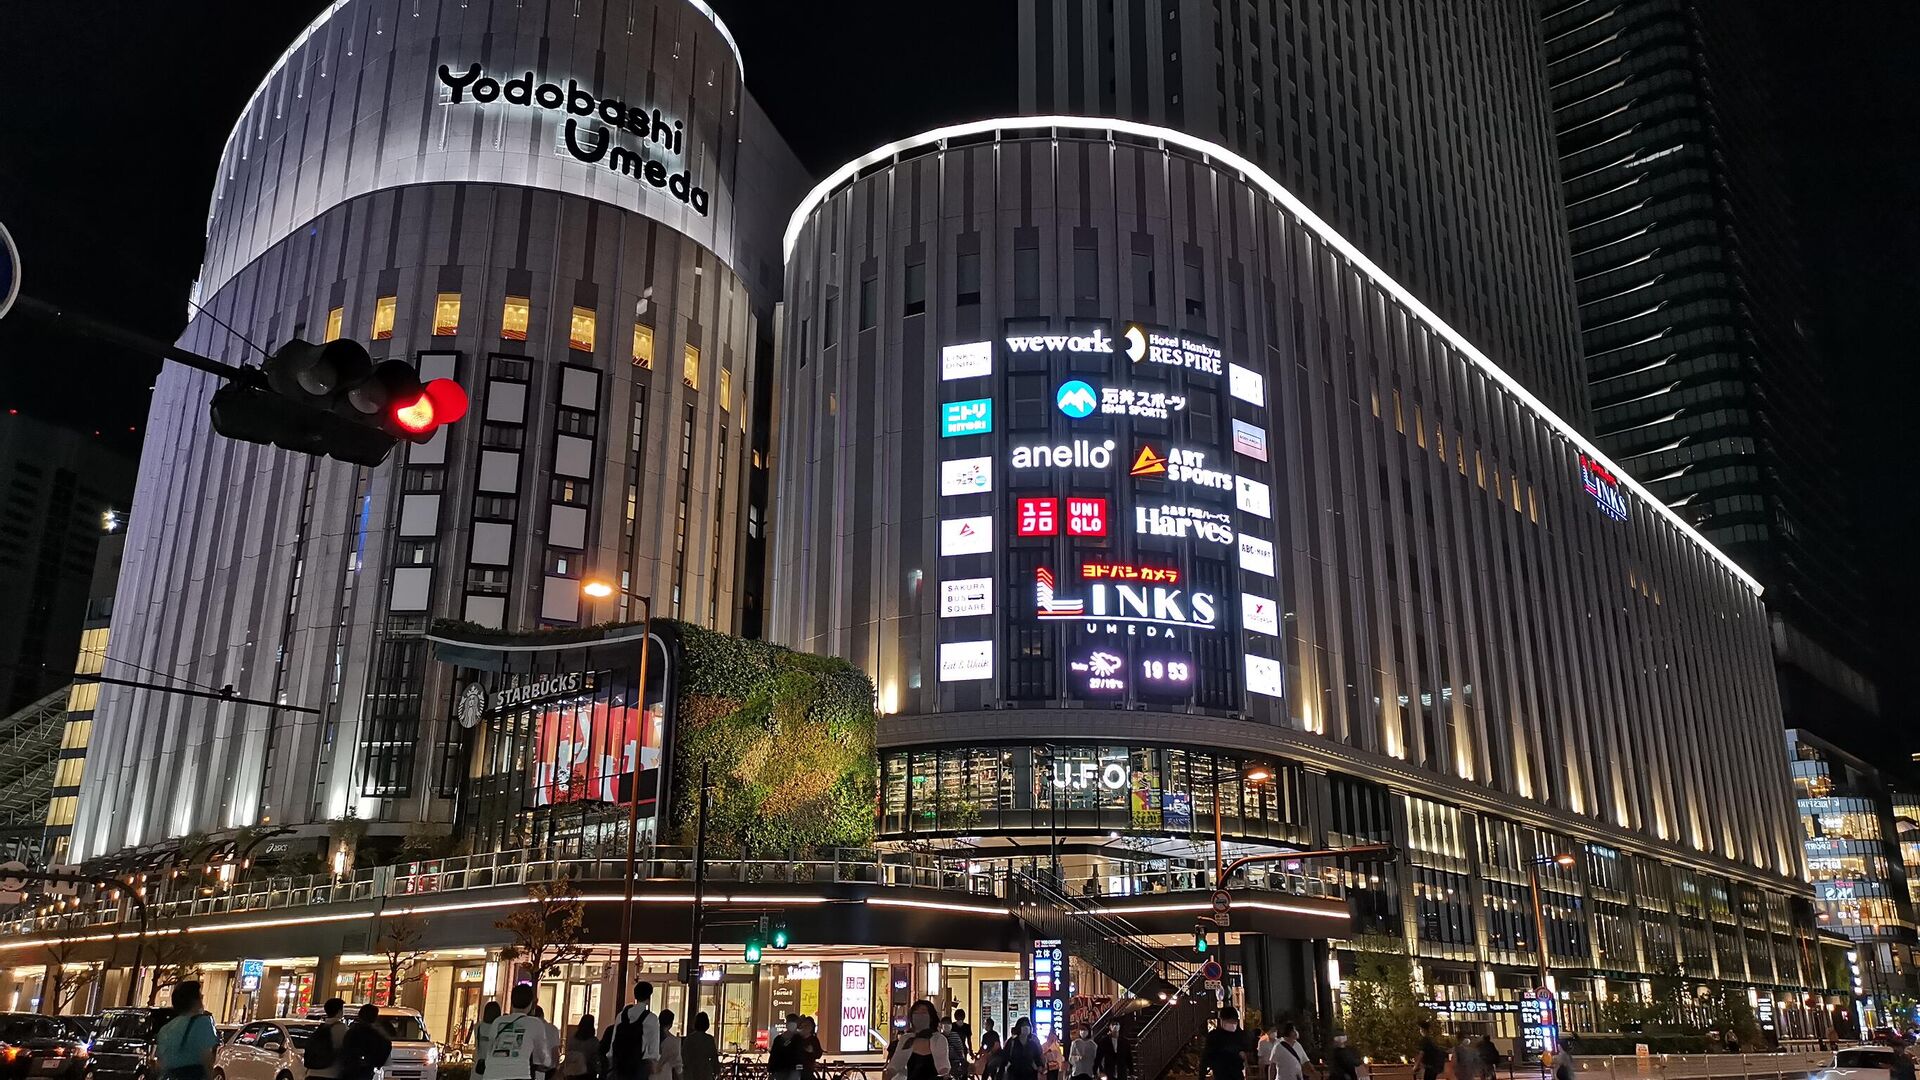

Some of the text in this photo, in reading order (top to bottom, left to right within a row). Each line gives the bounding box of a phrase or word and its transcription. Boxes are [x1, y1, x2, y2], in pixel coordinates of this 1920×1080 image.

[438, 63, 683, 155] Yodobashi
[565, 118, 709, 217] Umeda
[1006, 329, 1113, 353] wework
[1149, 334, 1221, 358] Hotel Hankyu
[1149, 346, 1222, 375] RESPIRE
[1102, 388, 1185, 411] 石井スポーツ
[947, 402, 987, 422] ニトリ
[1129, 405, 1167, 419] SPORTS
[947, 420, 987, 433] NITORI
[1012, 440, 1110, 468] anello
[1168, 448, 1205, 468] ART
[1168, 464, 1233, 490] SPORTS
[1071, 502, 1099, 516] UNI
[1071, 517, 1102, 533] QLO
[1136, 507, 1233, 544] Harves
[948, 583, 985, 592] SAKURA
[1037, 568, 1215, 624] LINKS
[948, 603, 986, 613] SQUARE
[1087, 623, 1176, 639] UMEDA
[497, 674, 578, 706] STARBUCKS
[1035, 949, 1051, 958] 立体
[843, 1006, 867, 1020] NOW
[842, 1024, 866, 1037] OPEN
